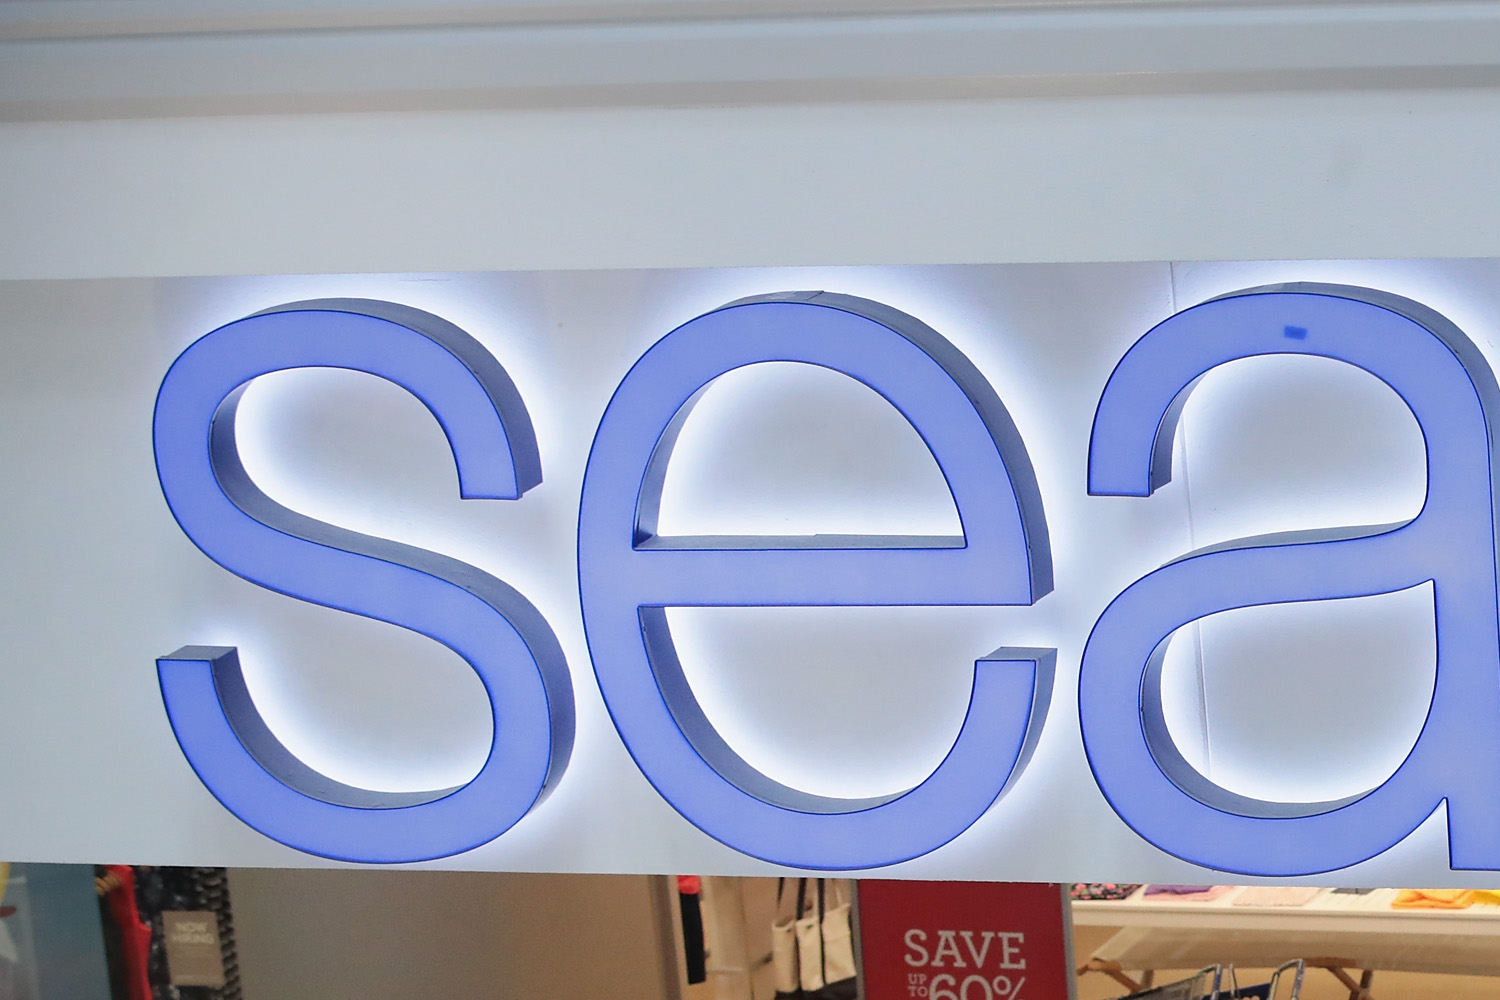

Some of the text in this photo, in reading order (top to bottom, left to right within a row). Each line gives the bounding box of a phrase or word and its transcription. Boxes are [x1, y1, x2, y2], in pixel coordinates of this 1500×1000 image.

[904, 929, 1027, 969] SAVE
[907, 973, 928, 985] UP
[907, 985, 929, 997] TO
